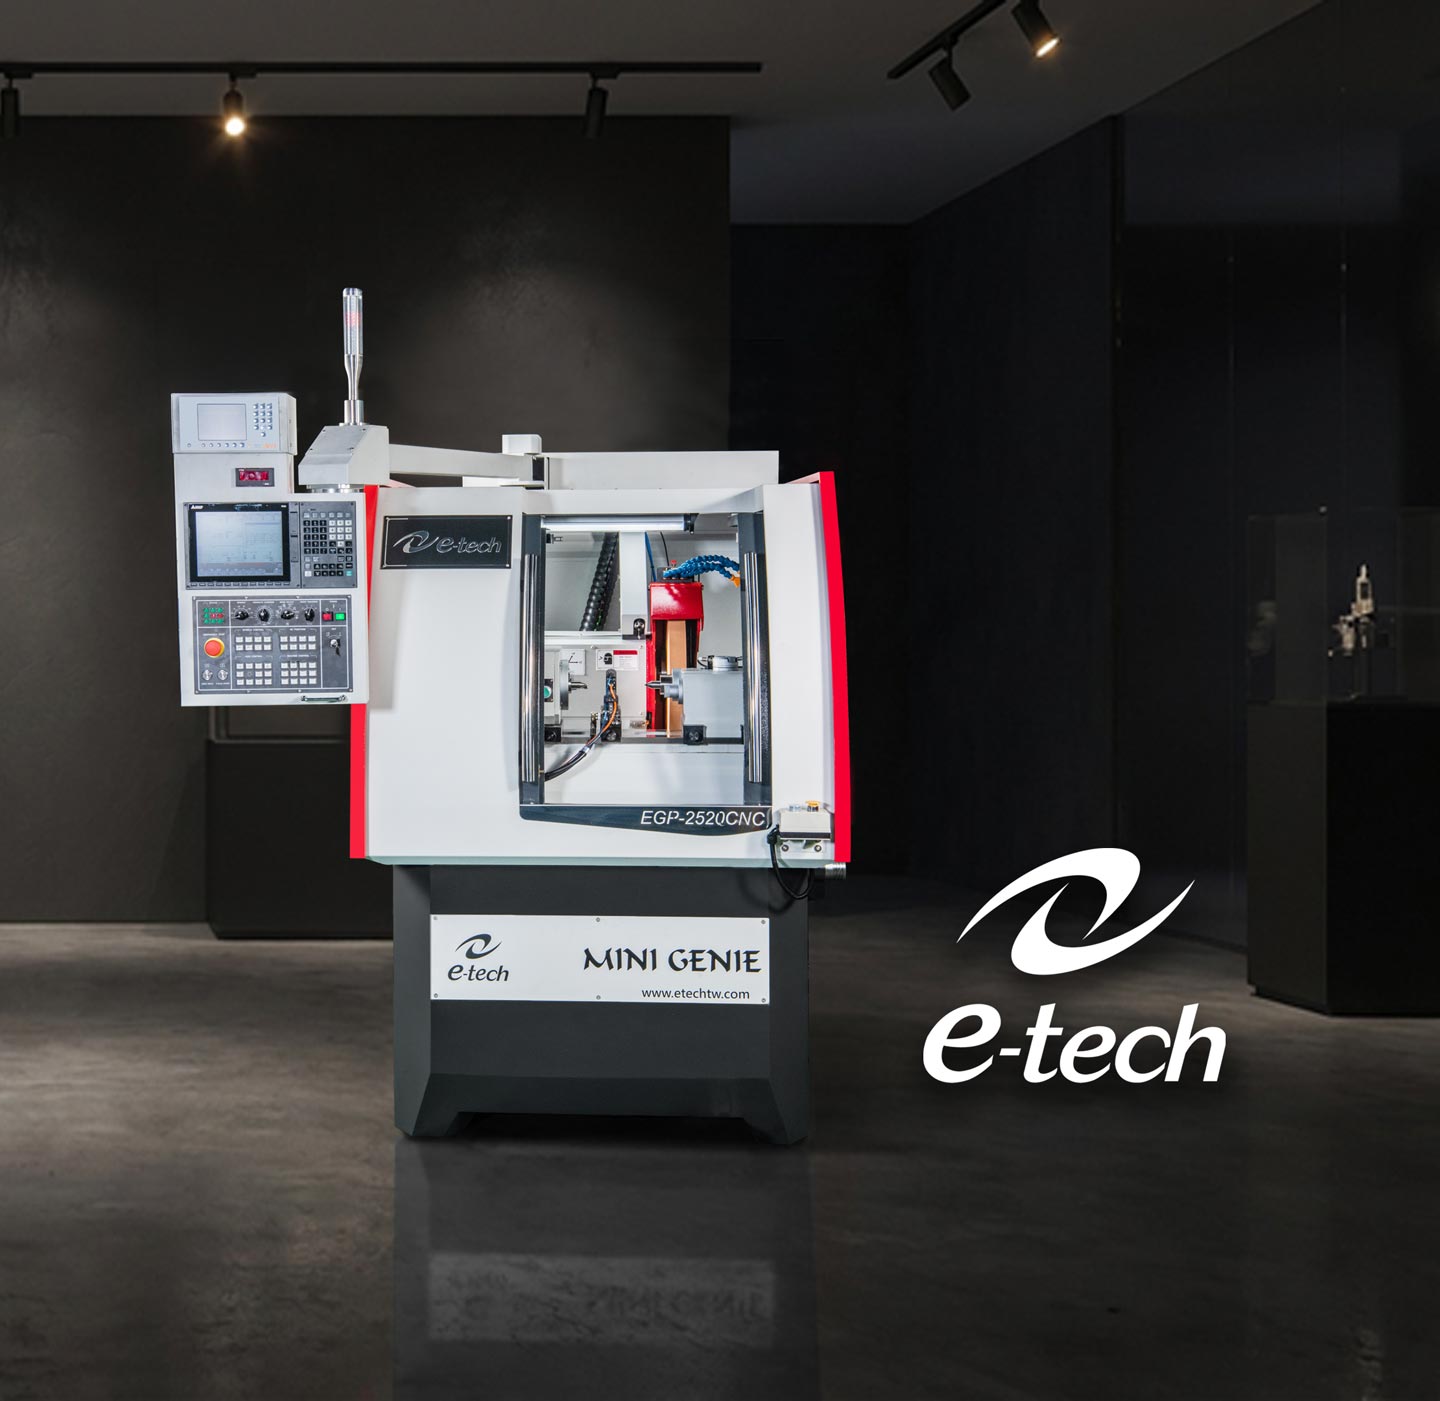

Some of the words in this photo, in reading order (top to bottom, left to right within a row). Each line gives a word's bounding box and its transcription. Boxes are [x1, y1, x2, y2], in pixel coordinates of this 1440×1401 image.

[436, 537, 502, 553] e-tech
[640, 810, 766, 827] EGP-2520CNC
[583, 947, 658, 972] MINI
[667, 948, 763, 974] GENIE
[447, 963, 510, 982] e-tech
[641, 987, 751, 1000] www.etechtw.com
